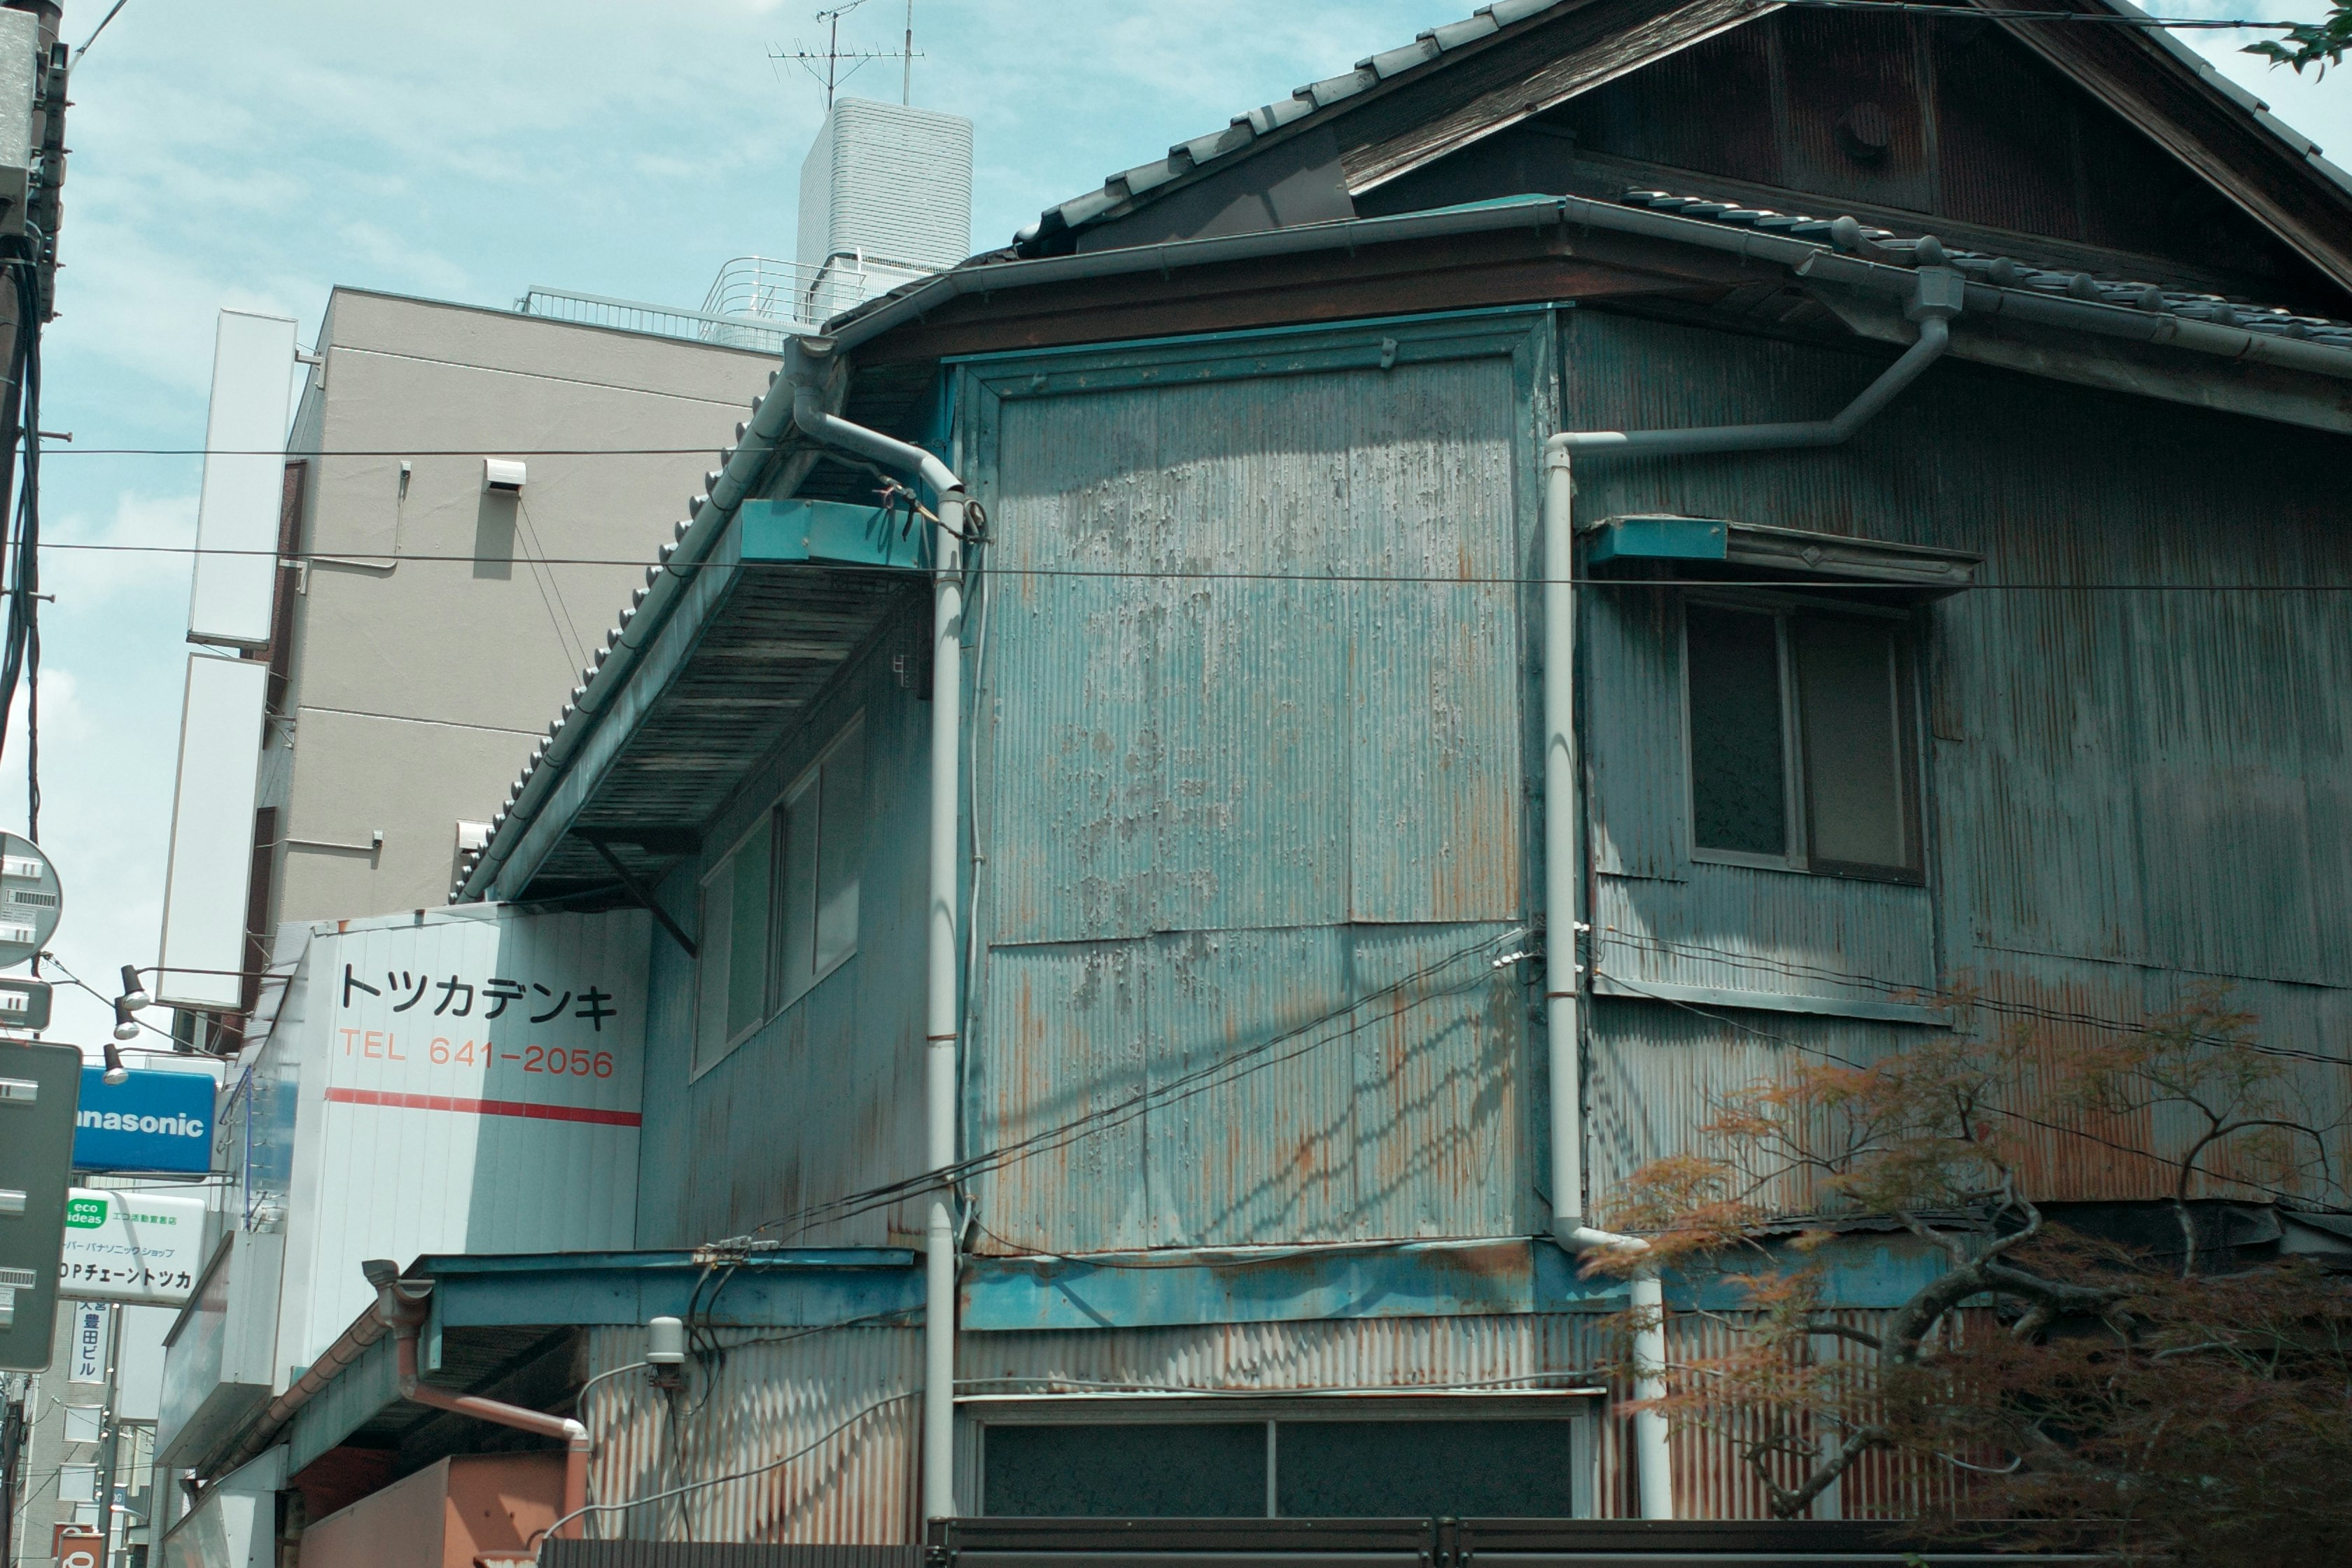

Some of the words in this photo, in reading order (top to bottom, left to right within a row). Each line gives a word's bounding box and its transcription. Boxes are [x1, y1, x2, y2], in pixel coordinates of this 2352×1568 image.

[343, 963, 617, 1031] トツカデンキ
[340, 1028, 405, 1060] TEL
[430, 1037, 613, 1078] 641-2056
[66, 1212, 102, 1224] ideas
[74, 1203, 98, 1212] eco
[80, 1313, 100, 1376] 豊田ビル
